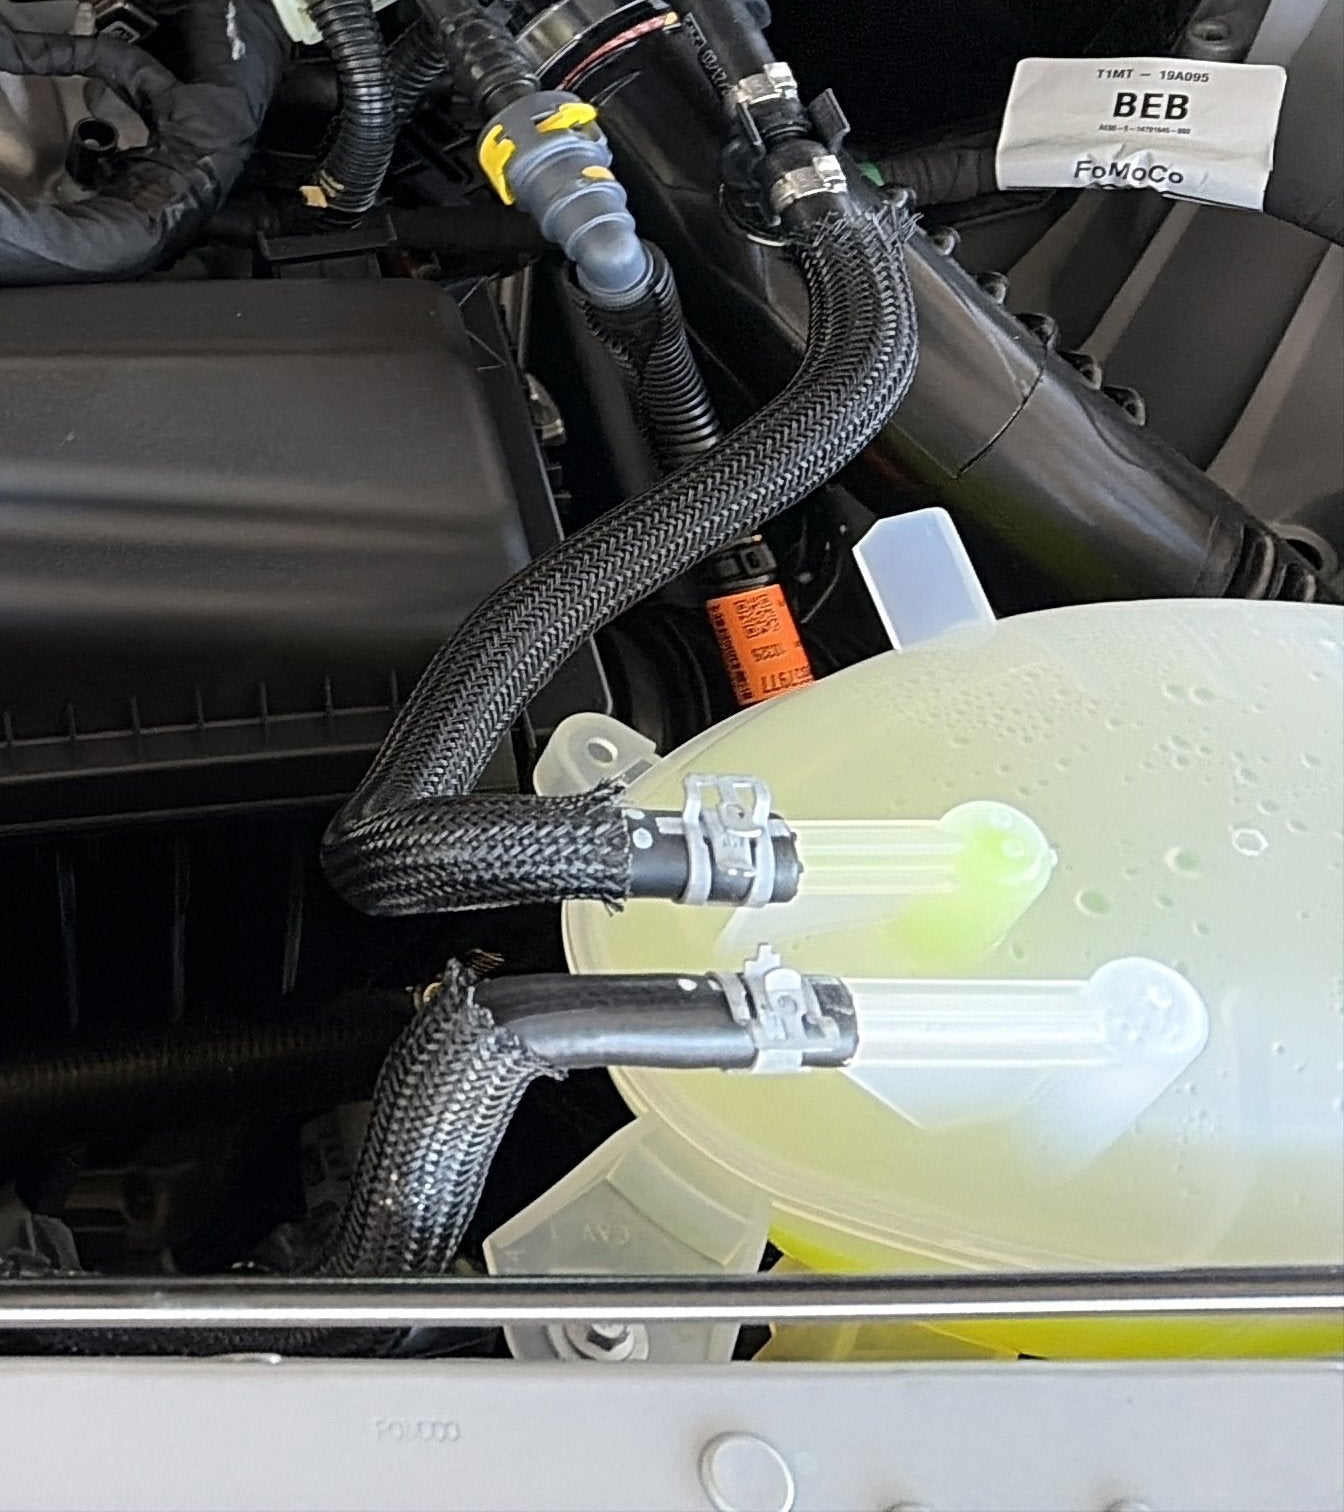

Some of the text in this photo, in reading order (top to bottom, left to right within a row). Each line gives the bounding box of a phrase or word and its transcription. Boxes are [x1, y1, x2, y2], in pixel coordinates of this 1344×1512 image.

[1096, 68, 1134, 80] T1MT
[1159, 69, 1210, 83] 19A095
[1112, 91, 1190, 121] BEB
[1073, 160, 1185, 185] FoMoCo
